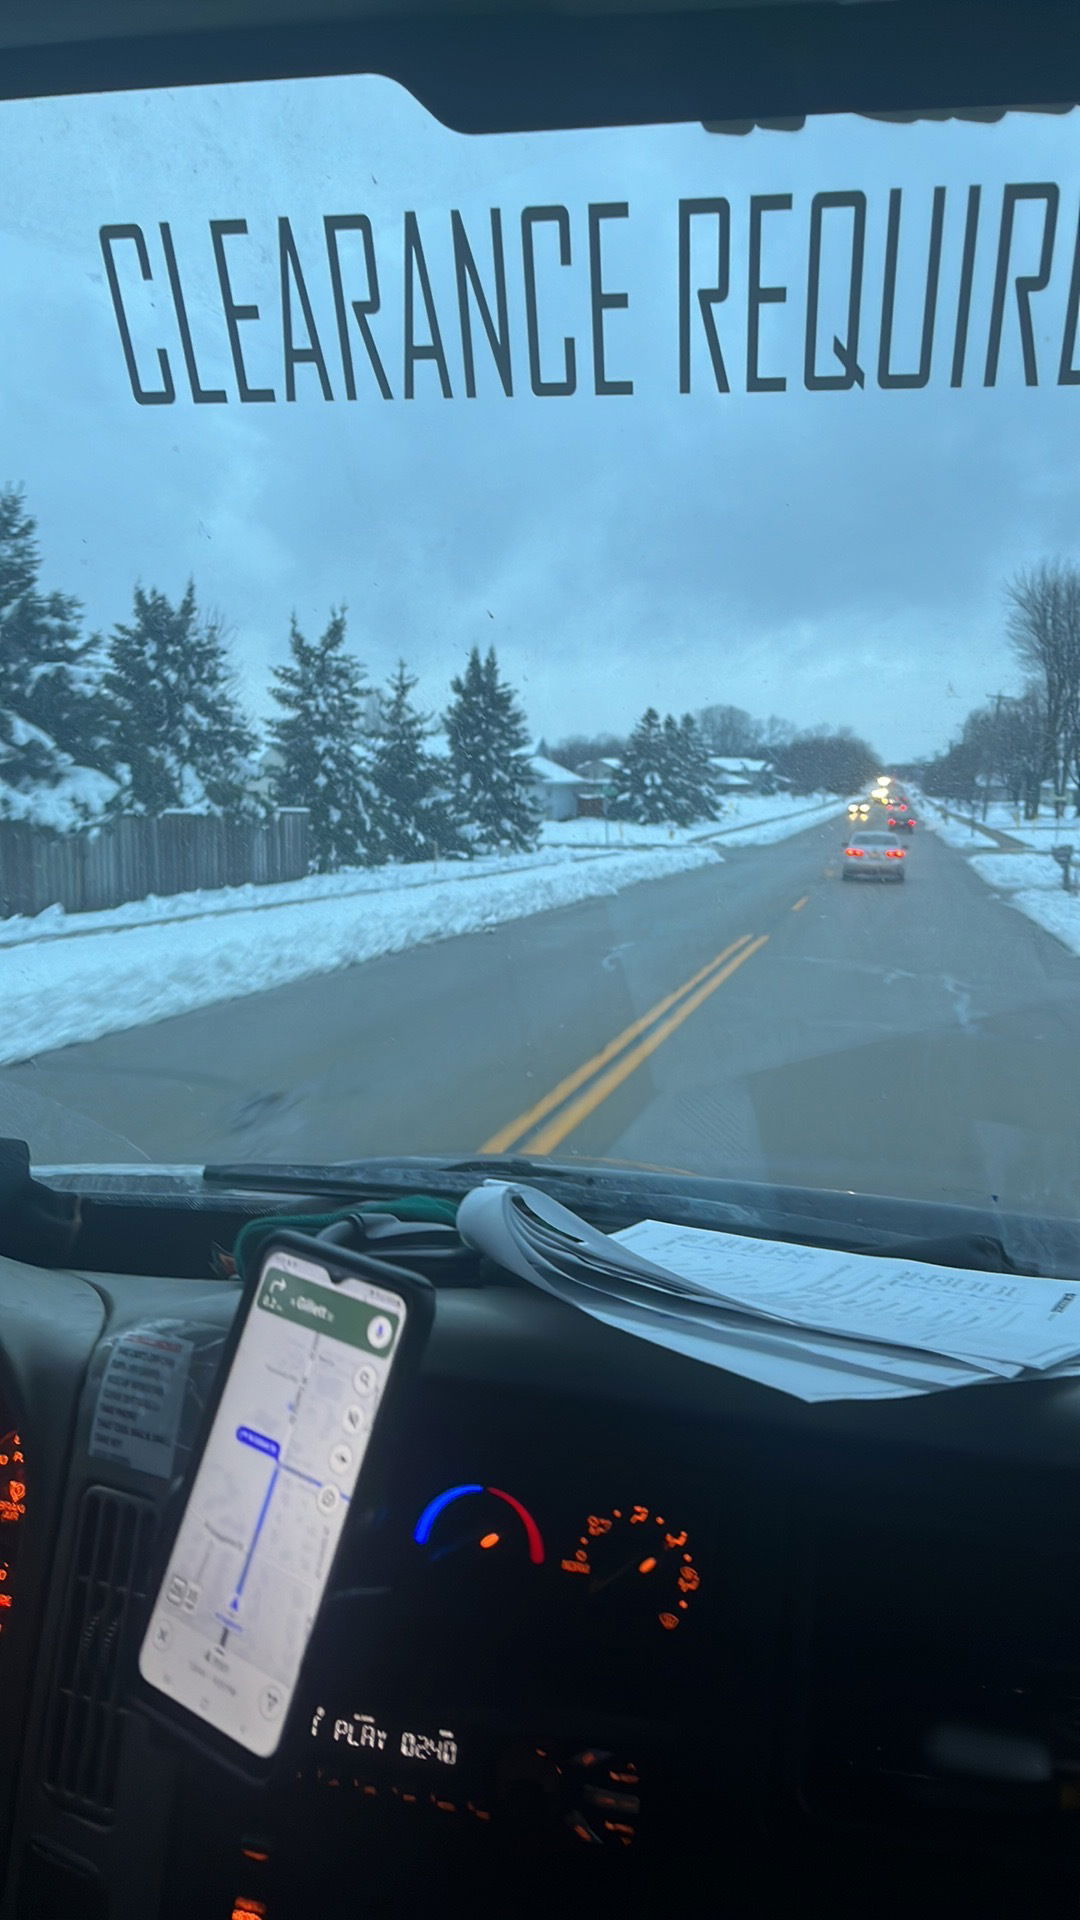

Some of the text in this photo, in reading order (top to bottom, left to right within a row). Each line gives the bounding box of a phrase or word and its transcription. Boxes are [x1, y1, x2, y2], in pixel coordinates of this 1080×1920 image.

[99, 200, 634, 405] CLEARANCE
[333, 1719, 388, 1751] PLAY
[400, 1731, 458, 1766] 0240
